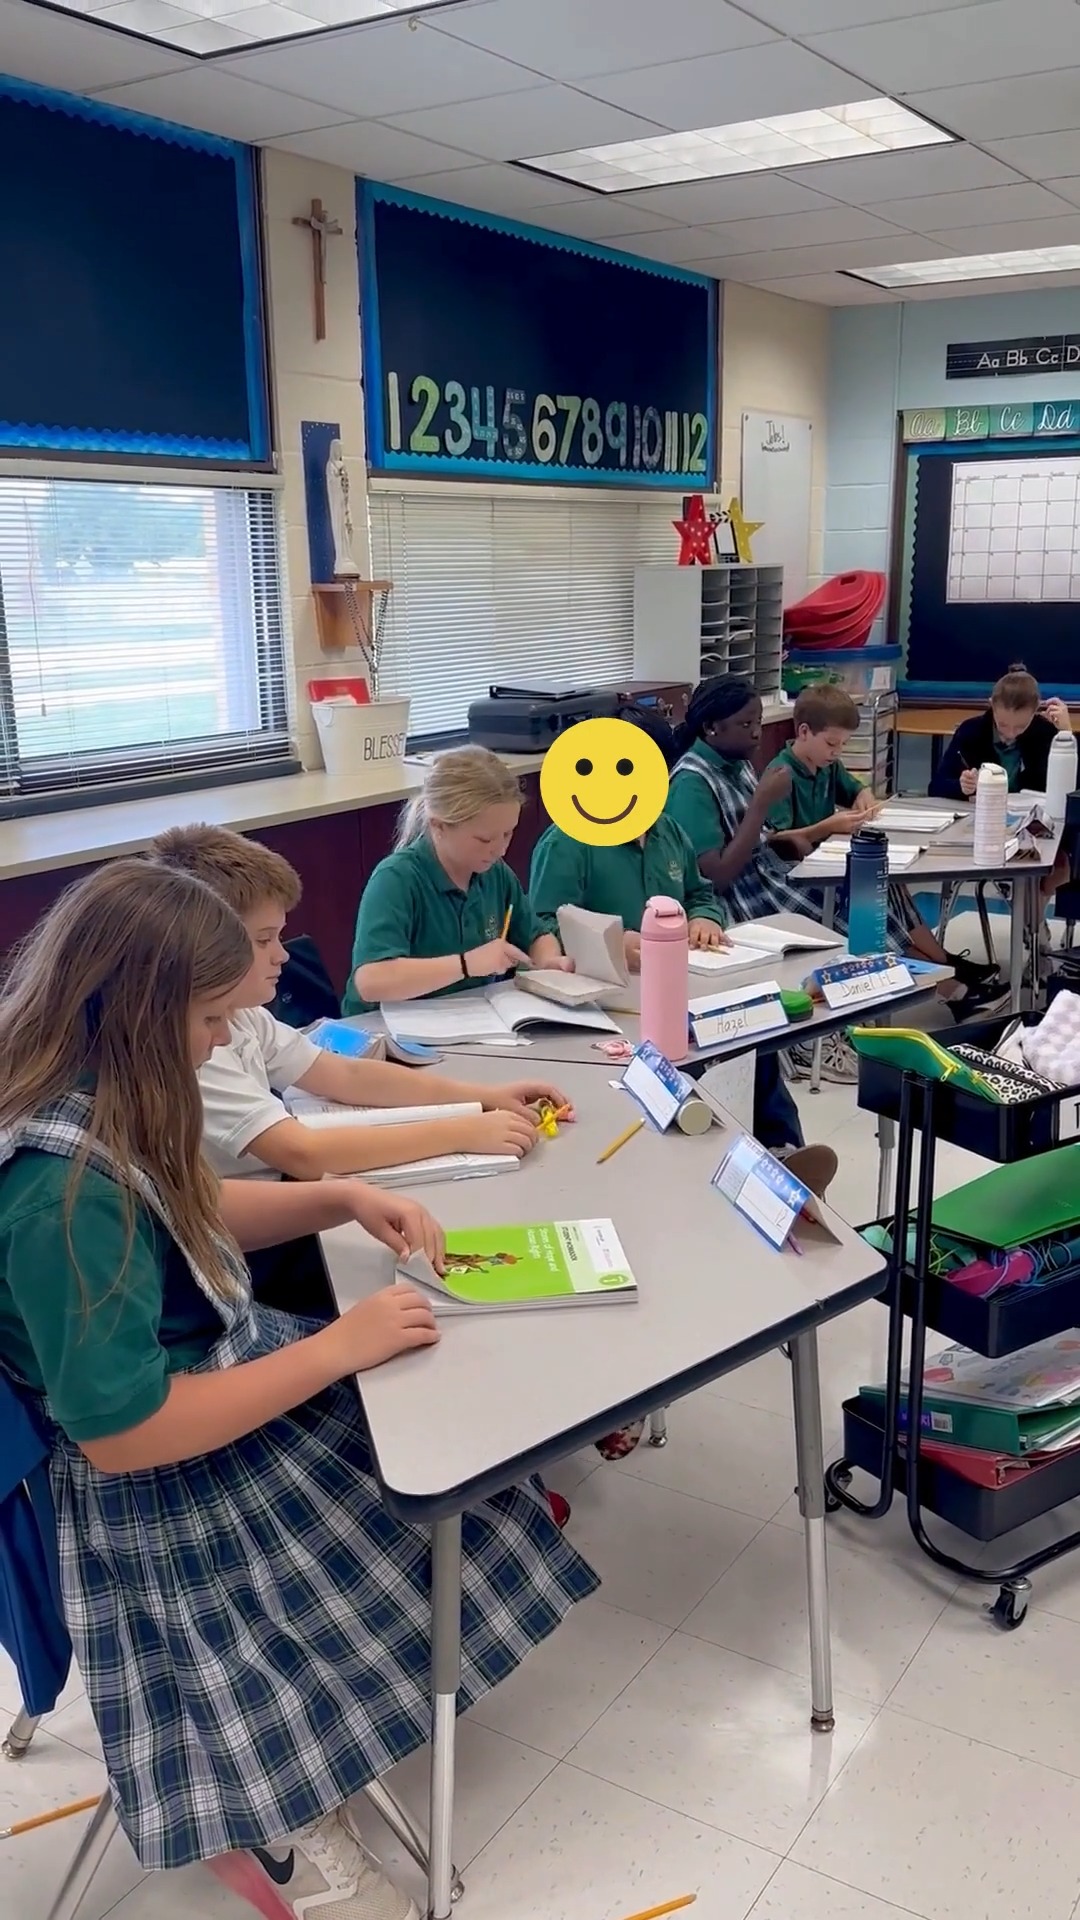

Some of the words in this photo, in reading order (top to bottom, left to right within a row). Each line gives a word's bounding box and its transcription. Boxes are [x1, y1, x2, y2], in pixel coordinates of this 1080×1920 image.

[976, 352, 999, 369] Aa
[1006, 350, 1028, 367] Bb
[1036, 347, 1059, 365] Cc
[388, 371, 401, 450] 1
[410, 375, 440, 452] 2
[444, 380, 472, 455] 3
[471, 385, 498, 457] 4
[503, 388, 528, 460] 5
[532, 394, 557, 463] 6
[556, 395, 581, 464] 7
[581, 397, 603, 464] 8
[605, 401, 627, 466] 9
[633, 405, 662, 468] 10
[664, 411, 679, 472] 11
[681, 412, 708, 472] 12
[910, 411, 938, 437] Aa
[954, 410, 984, 436] Bb
[1000, 404, 1025, 432] Cc
[1037, 404, 1075, 431] Dd
[842, 976, 876, 998] Daniel
[717, 1010, 748, 1038] Hazel
